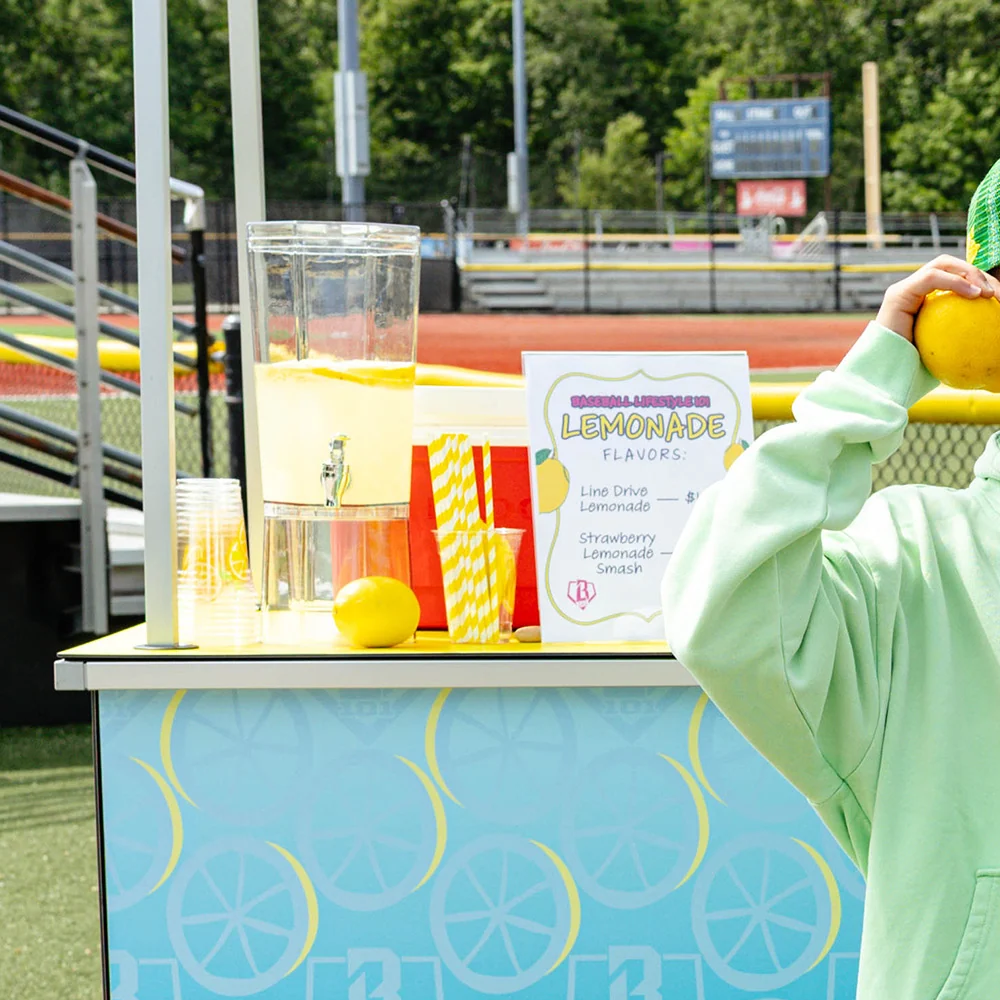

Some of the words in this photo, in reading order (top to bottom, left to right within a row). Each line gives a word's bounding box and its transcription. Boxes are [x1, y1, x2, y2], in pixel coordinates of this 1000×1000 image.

[570, 395, 632, 409] BASEBALL
[634, 395, 692, 409] LIFESTYLE
[693, 395, 711, 408] 101
[561, 412, 726, 442] LEMONADE
[603, 447, 688, 461] FLAVORS:
[580, 484, 609, 498] Line
[613, 484, 649, 498] Drive
[580, 499, 651, 513] Lemonade
[578, 531, 656, 547] Strawberry
[583, 547, 654, 560] Lemonade
[596, 562, 643, 575] Smash
